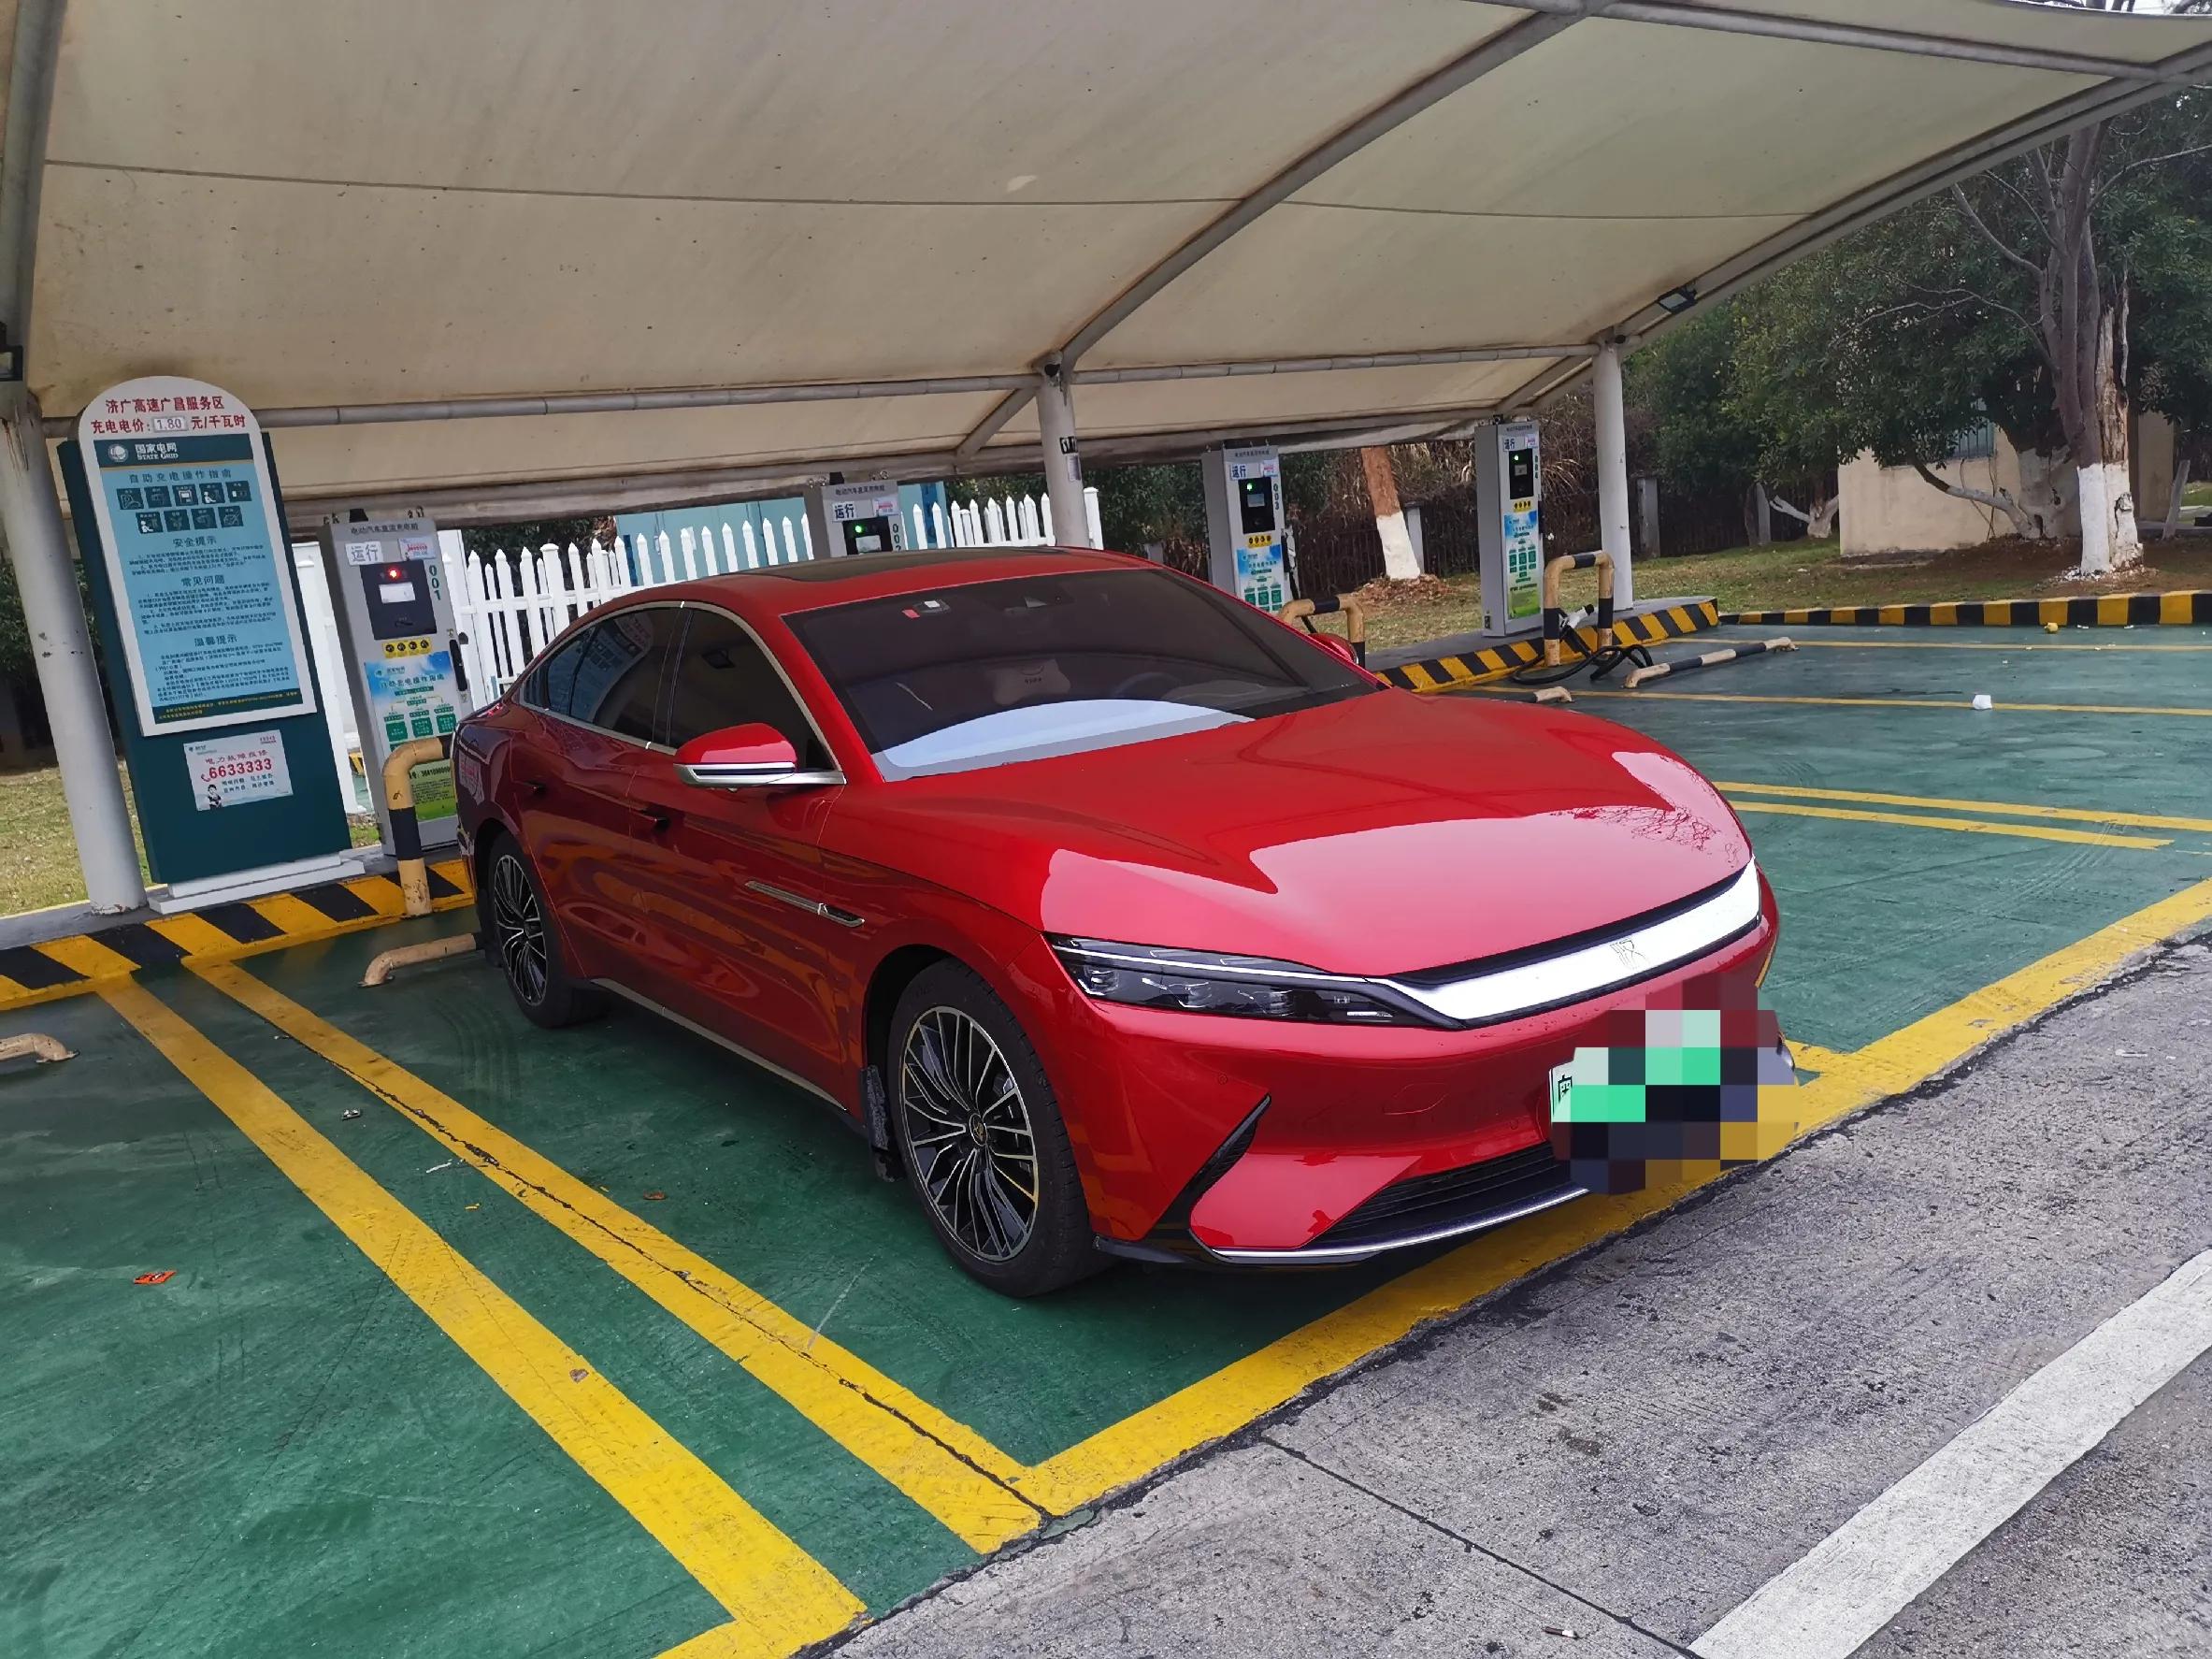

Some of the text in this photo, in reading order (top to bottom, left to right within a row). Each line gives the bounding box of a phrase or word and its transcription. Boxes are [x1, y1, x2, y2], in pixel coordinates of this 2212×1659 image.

[105, 396, 225, 413] 济广高速广昌服务区
[156, 418, 182, 430] 1.80
[191, 414, 246, 430] 元/千瓦时
[135, 442, 178, 454] 国家电网
[834, 504, 855, 519] 运行
[173, 536, 217, 548] 安全提示
[351, 543, 379, 562] 运行
[181, 574, 225, 587] 常见问题
[429, 565, 441, 600] 001
[194, 634, 237, 647] 温馨提示
[208, 757, 272, 779] 6633333
